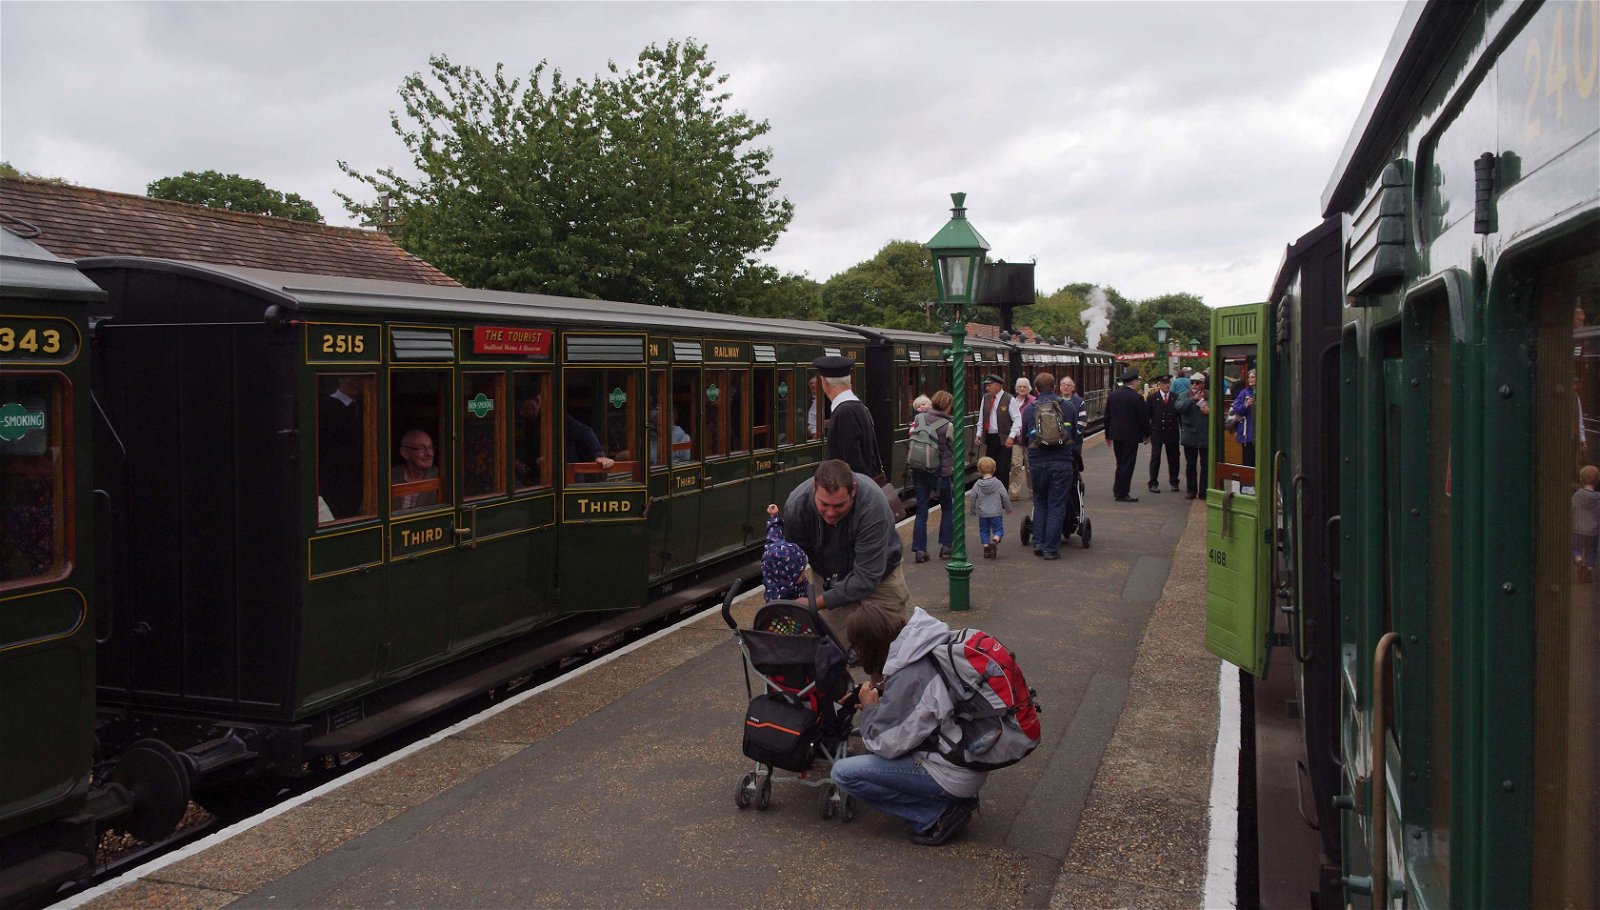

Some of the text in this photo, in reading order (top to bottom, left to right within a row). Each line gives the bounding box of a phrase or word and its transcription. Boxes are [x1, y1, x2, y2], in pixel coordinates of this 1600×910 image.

[0, 327, 60, 353] 343
[323, 334, 364, 353] 2515
[485, 329, 542, 343] THE TOURIST
[714, 346, 740, 358] RAILWAY
[676, 476, 696, 488] THIRD
[577, 498, 631, 514] THIRD
[401, 527, 443, 547] THIRD
[1209, 548, 1227, 567] 4168
